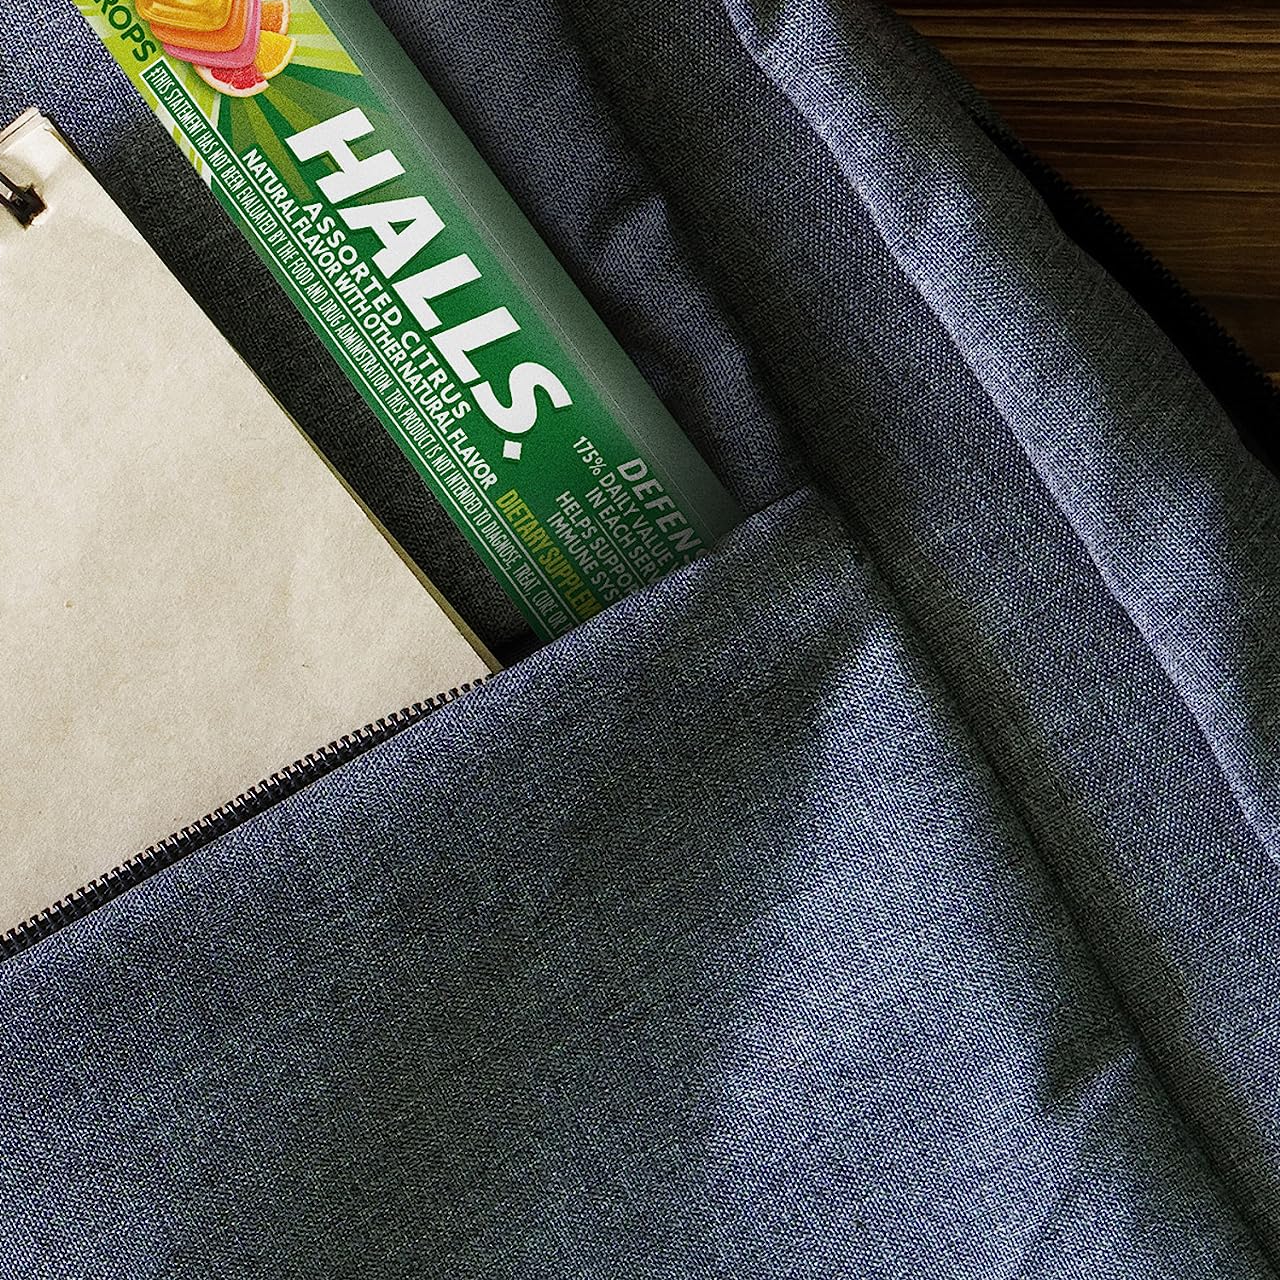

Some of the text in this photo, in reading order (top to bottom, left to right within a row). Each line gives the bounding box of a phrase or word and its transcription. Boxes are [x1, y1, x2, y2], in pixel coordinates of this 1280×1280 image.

[163, 88, 207, 137] STATEMENT
[194, 130, 218, 154] HAS
[207, 147, 232, 171] NOT
[220, 164, 247, 192] BEEN
[235, 185, 277, 234] EVALUATED
[267, 228, 287, 246] BY
[276, 240, 299, 264] THE
[287, 256, 315, 285] FOOD
[303, 280, 328, 303] AND
[241, 148, 497, 490] NATURAL FLAVOR WITH OTHER NATURAL FLAVOR
[301, 202, 471, 418] ASSORTED CITRUS
[317, 297, 345, 327] DRUG
[334, 322, 394, 393] ADMINISTRATION.
[384, 387, 409, 413] THIS
[397, 407, 436, 449] PRODUCT
[424, 443, 442, 458] IS
[431, 452, 455, 476] NOT
[443, 469, 482, 514] INTENDED
[572, 435, 606, 475] 175%
[598, 471, 639, 516] DAILY
[631, 514, 673, 566] VALUE
[472, 507, 491, 526] TO
[494, 487, 554, 557] DIETARY
[555, 490, 597, 539] HELPS
[584, 486, 607, 508] IN
[598, 504, 636, 548] EACH
[480, 520, 522, 566] DIAGNOSE,
[546, 510, 623, 608] IMMUNE SYS
[512, 561, 541, 592] TREAT,
[531, 589, 558, 616] CURE
[547, 610, 567, 629] OR
